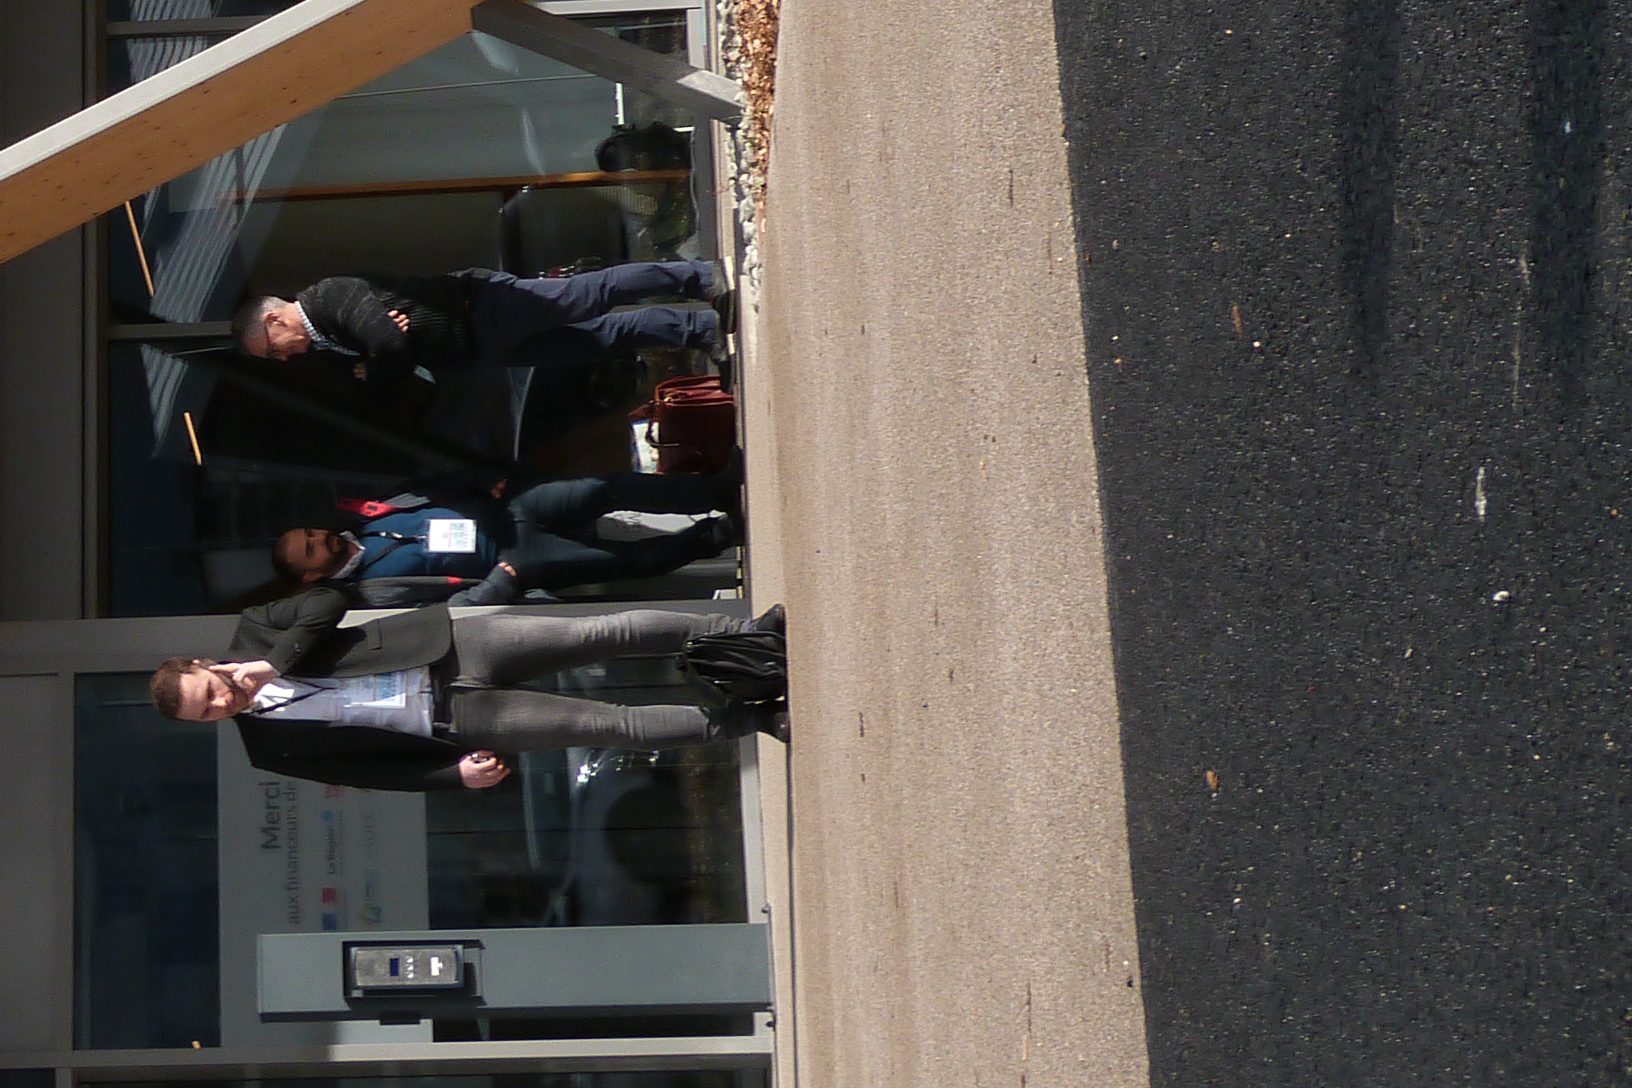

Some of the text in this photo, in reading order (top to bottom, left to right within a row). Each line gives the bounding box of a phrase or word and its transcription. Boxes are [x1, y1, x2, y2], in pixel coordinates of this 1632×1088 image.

[258, 780, 281, 849] Merci
[284, 804, 300, 892] financeurs
[326, 824, 337, 874] La Région
[287, 894, 300, 926] aux
